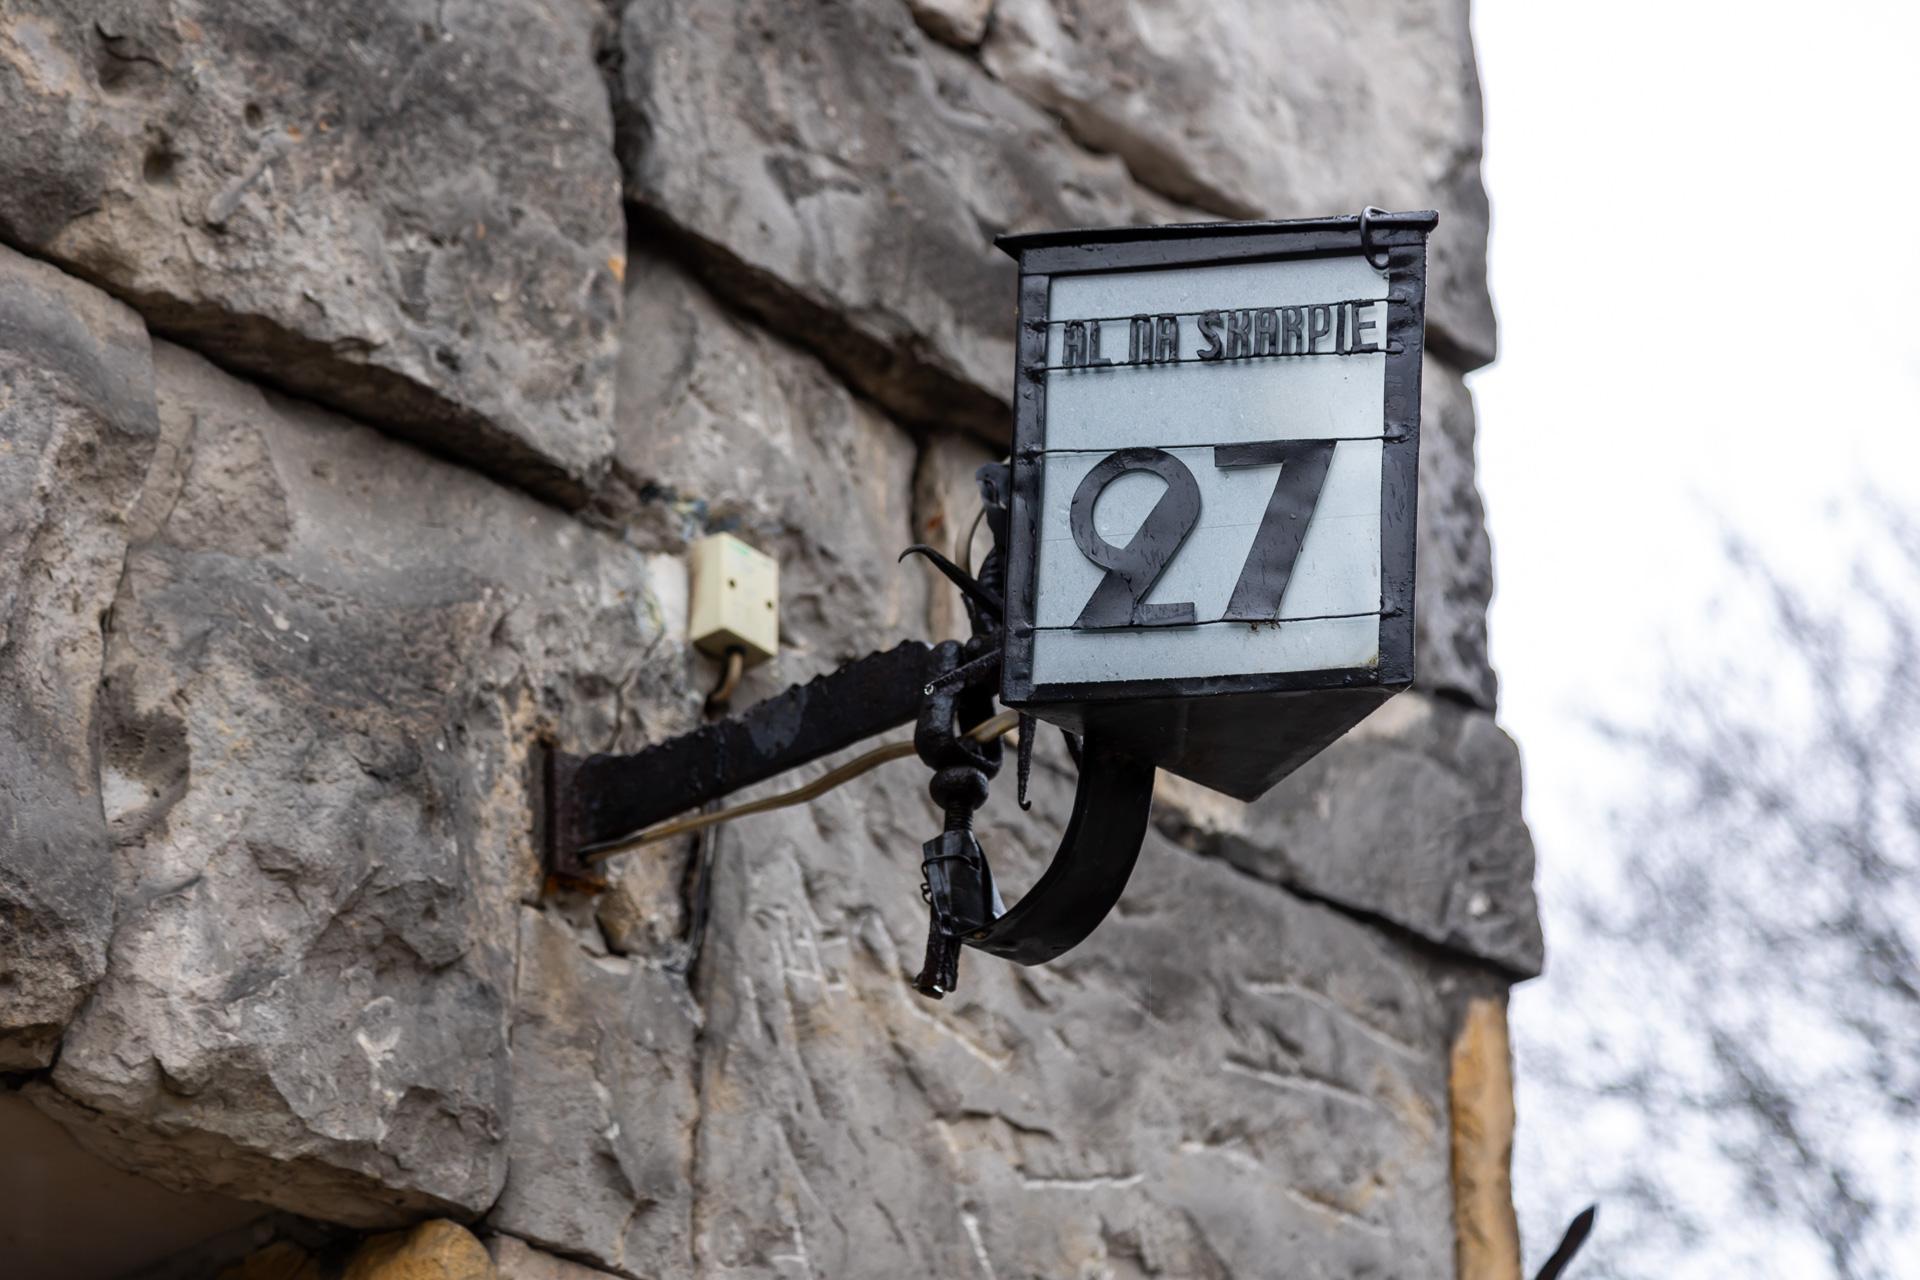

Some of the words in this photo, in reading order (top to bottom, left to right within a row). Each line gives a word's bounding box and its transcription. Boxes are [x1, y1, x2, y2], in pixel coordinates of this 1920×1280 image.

[1128, 313, 1180, 364] NA
[1196, 300, 1378, 360] SKARPIE
[1069, 439, 1338, 629] 27
